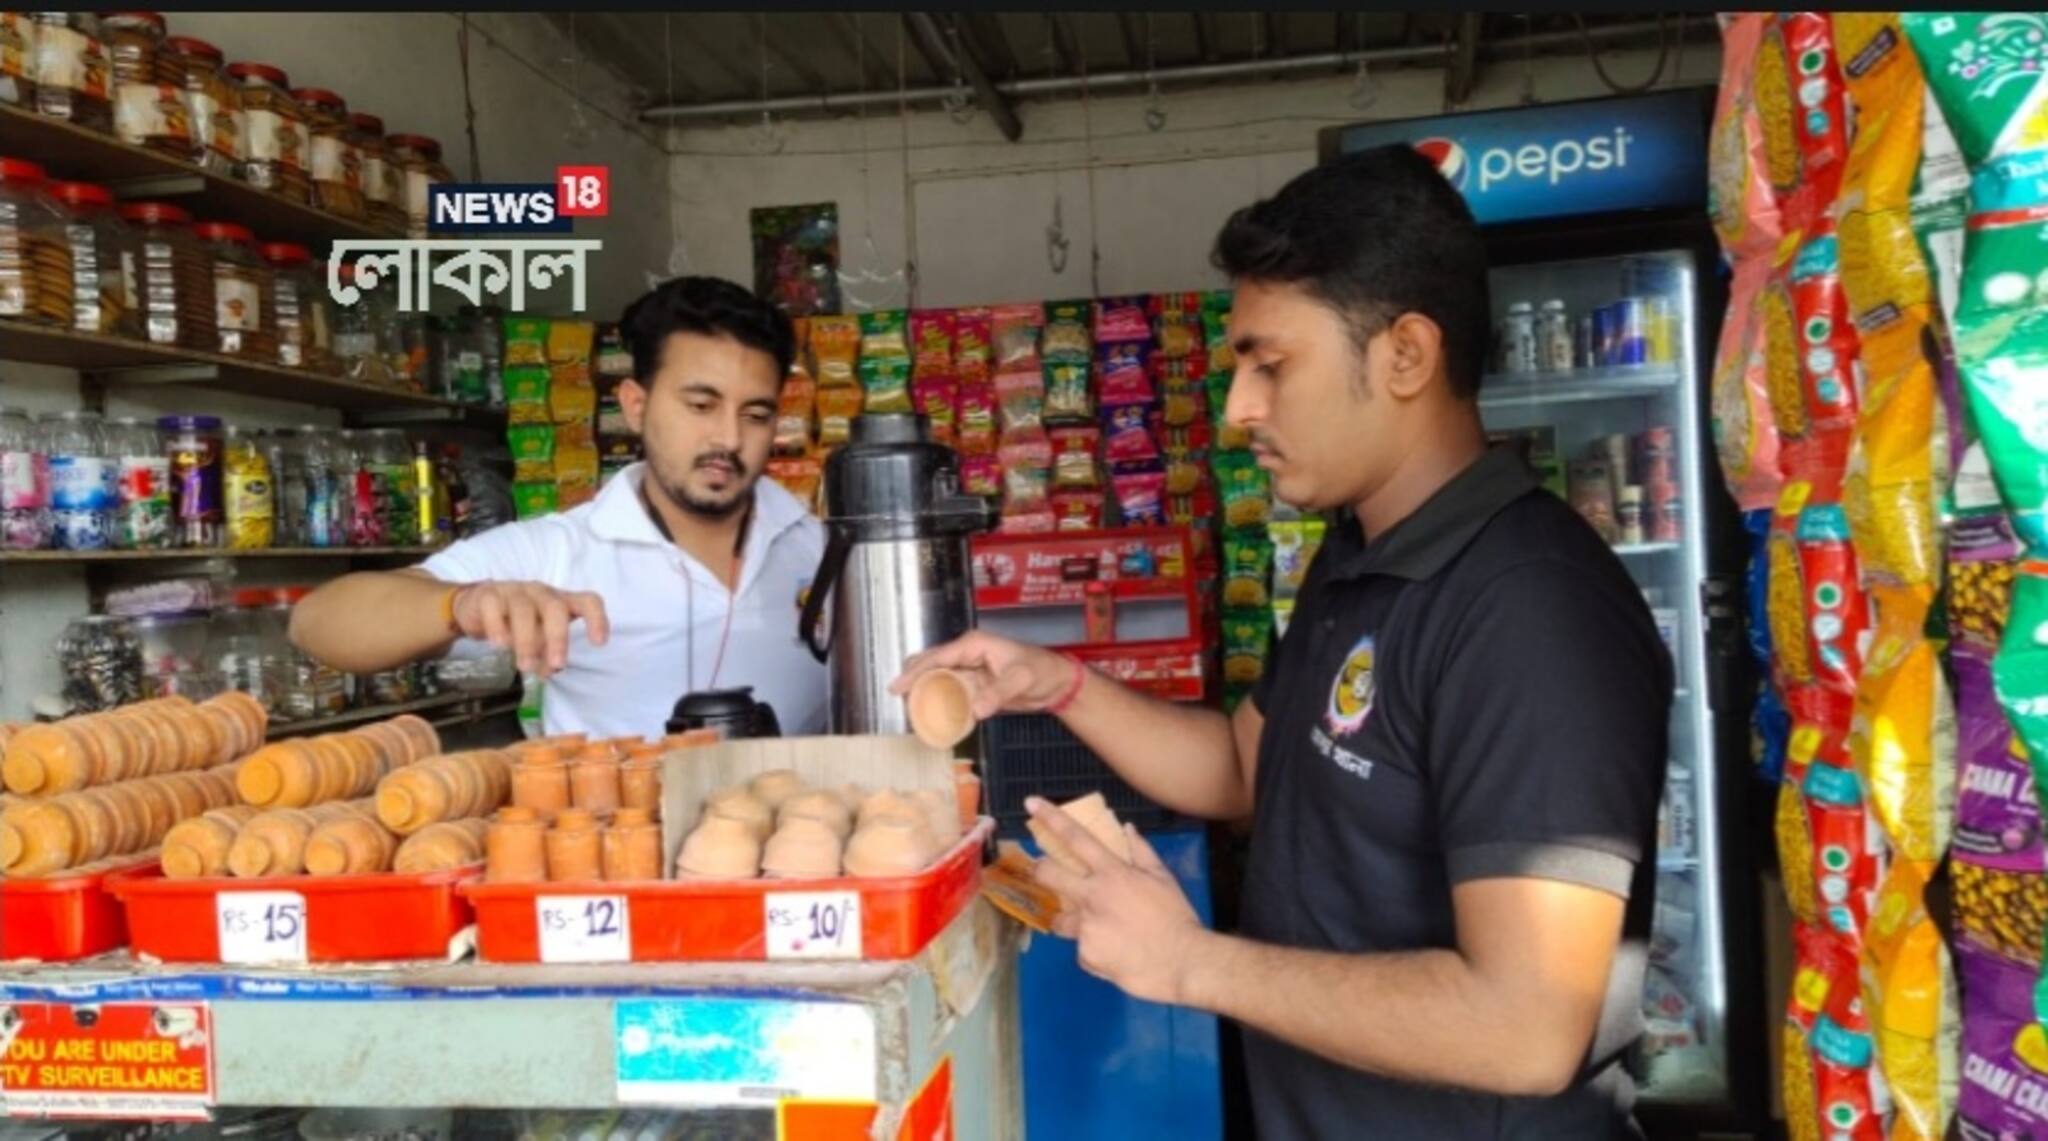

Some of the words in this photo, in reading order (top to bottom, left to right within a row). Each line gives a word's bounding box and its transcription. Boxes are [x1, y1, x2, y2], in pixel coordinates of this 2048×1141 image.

[1479, 127, 1627, 192] pepsi
[8, 1038, 46, 1062] OU
[53, 1039, 97, 1062] ARE
[101, 1039, 177, 1063] UNDER
[0, 1065, 33, 1086] TV
[40, 1066, 204, 1090] SURVEILLANCE
